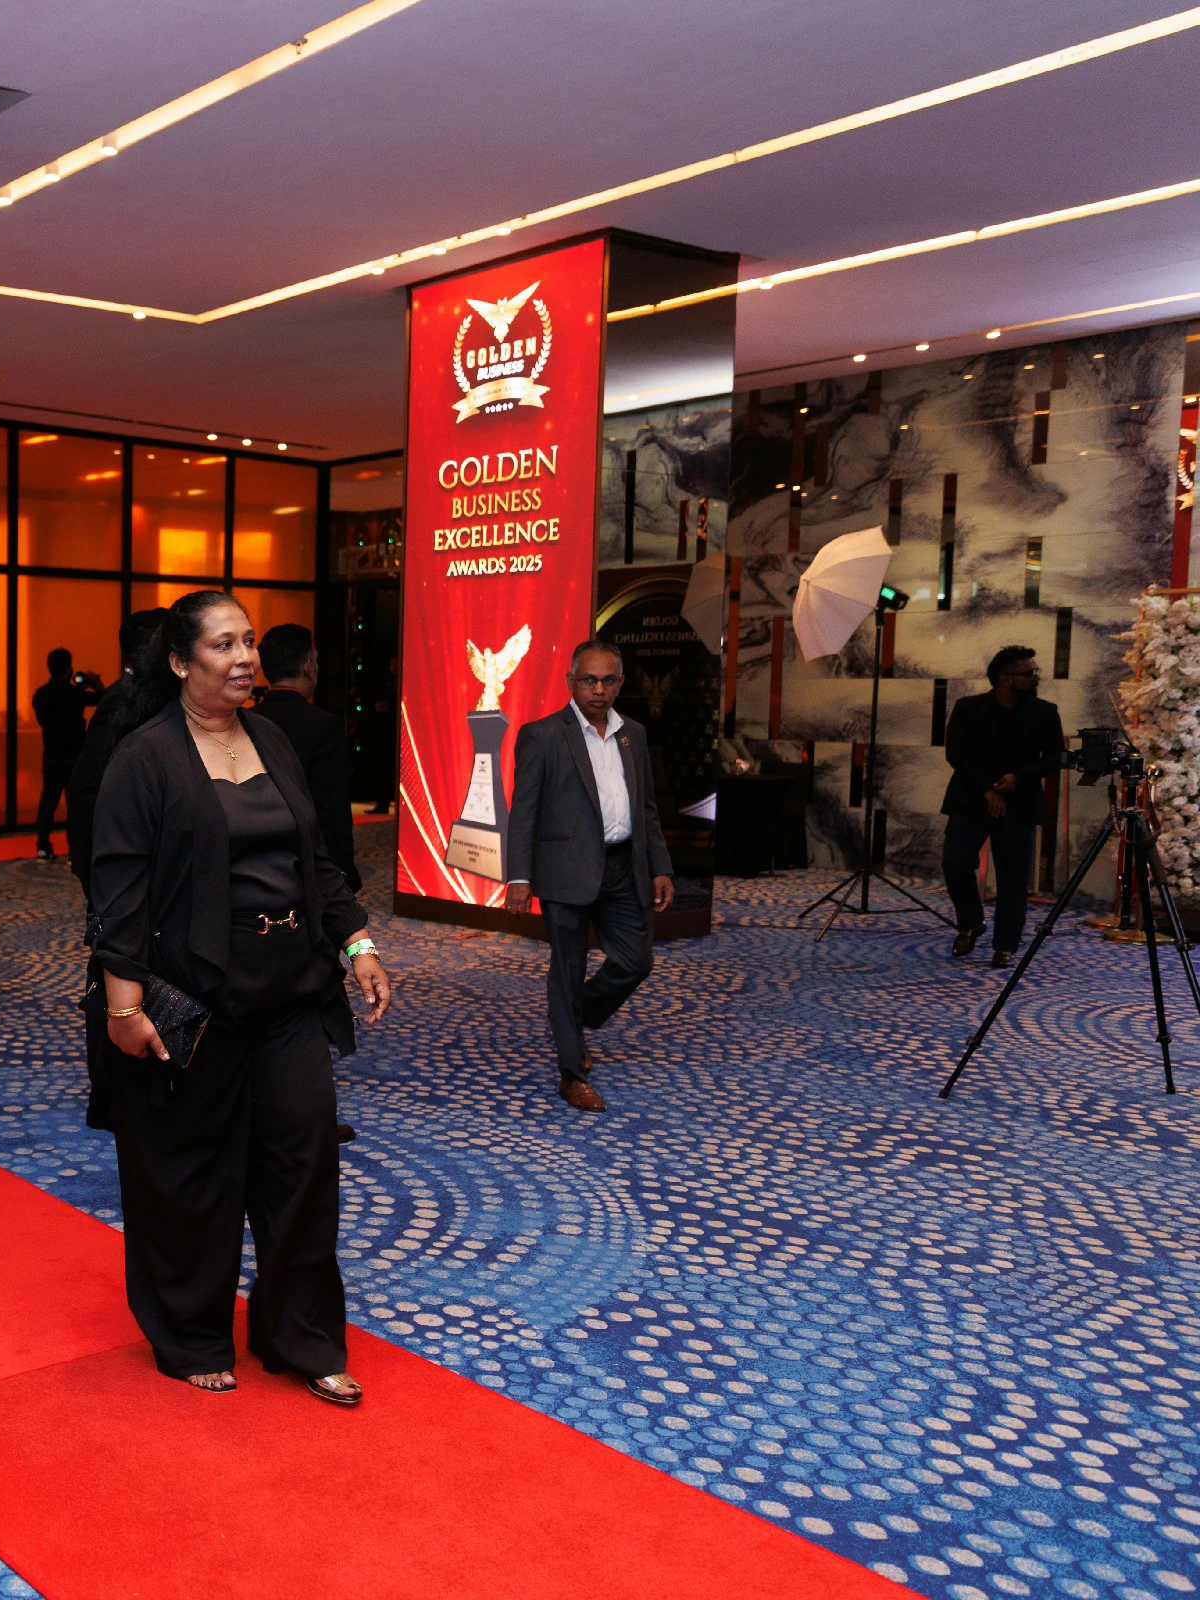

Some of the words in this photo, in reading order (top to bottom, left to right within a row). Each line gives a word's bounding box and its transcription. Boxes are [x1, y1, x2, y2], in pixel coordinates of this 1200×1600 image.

[466, 336, 537, 369] GOLDEN
[477, 359, 525, 381] BUSINESS
[438, 445, 559, 489] GOLDEN
[452, 488, 542, 519] BUSINESS
[433, 518, 560, 551] EXCELLENCE
[446, 556, 506, 577] AWARDS
[509, 554, 543, 573] 2025
